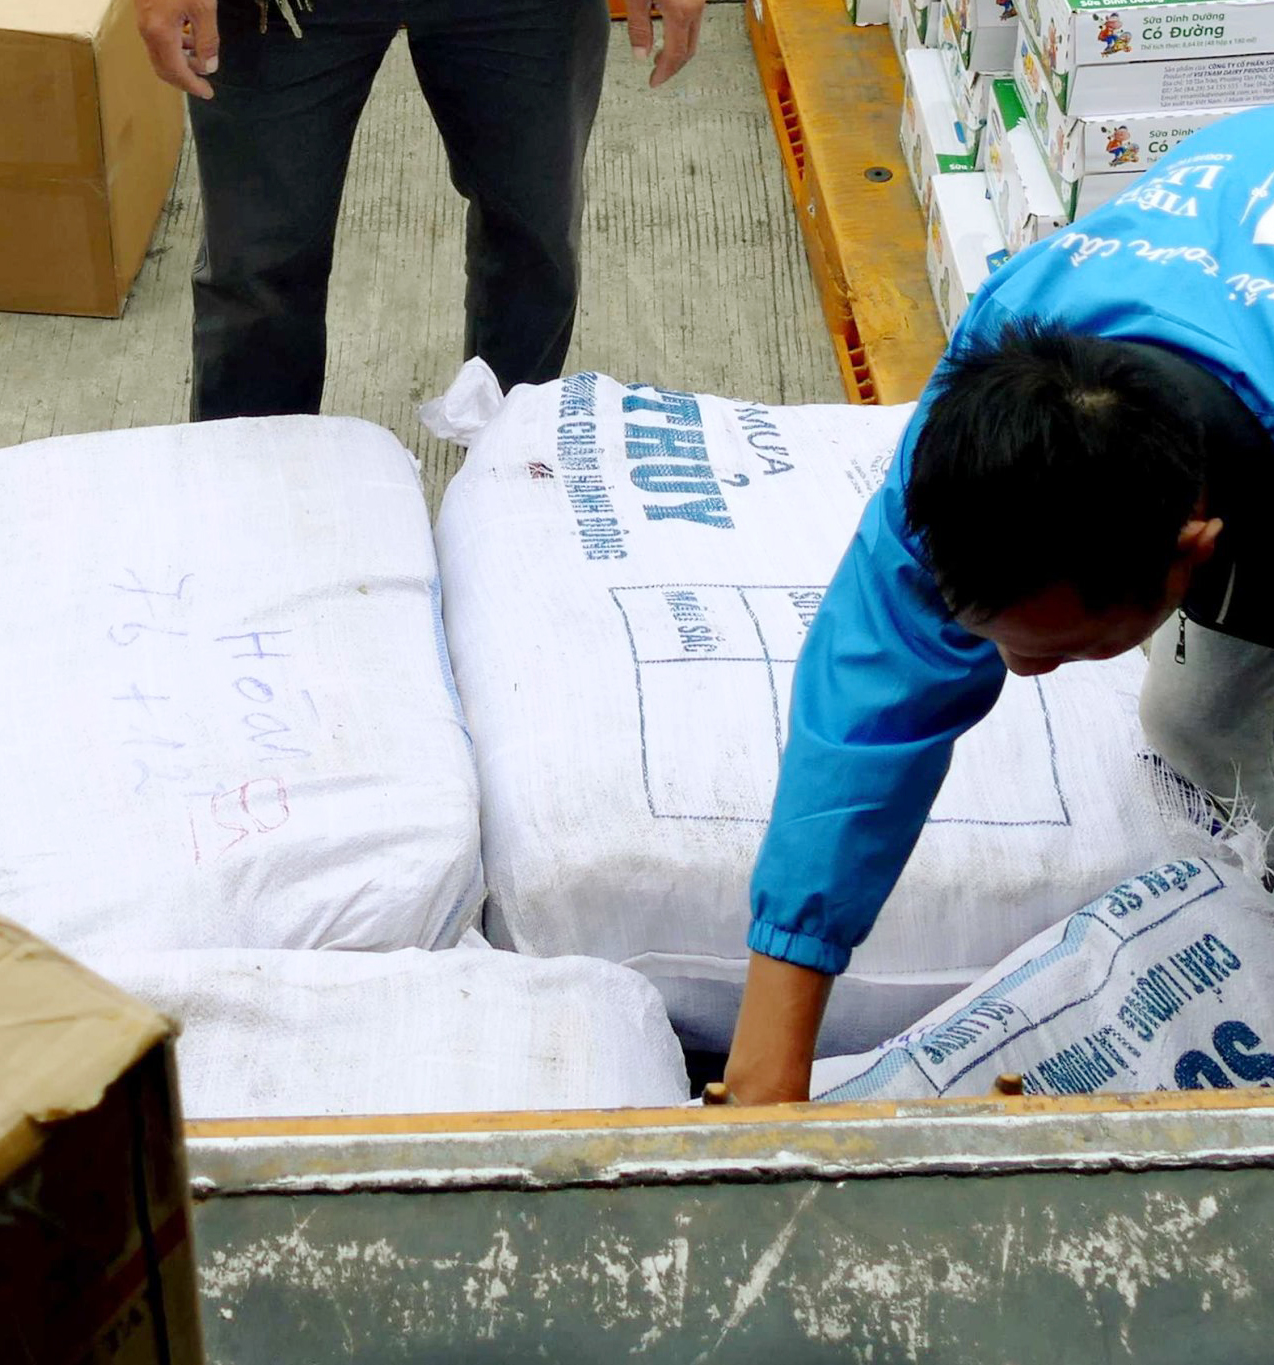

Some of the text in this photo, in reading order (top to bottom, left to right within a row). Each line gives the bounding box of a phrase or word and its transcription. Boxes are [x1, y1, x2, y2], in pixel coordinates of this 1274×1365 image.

[1079, 0, 1099, 8] Sữa
[1143, 11, 1225, 25] Sữa Dinh Dưỡng
[1142, 24, 1225, 41] Có Đường
[1149, 130, 1168, 140] Sữa
[1148, 140, 1168, 155] Có
